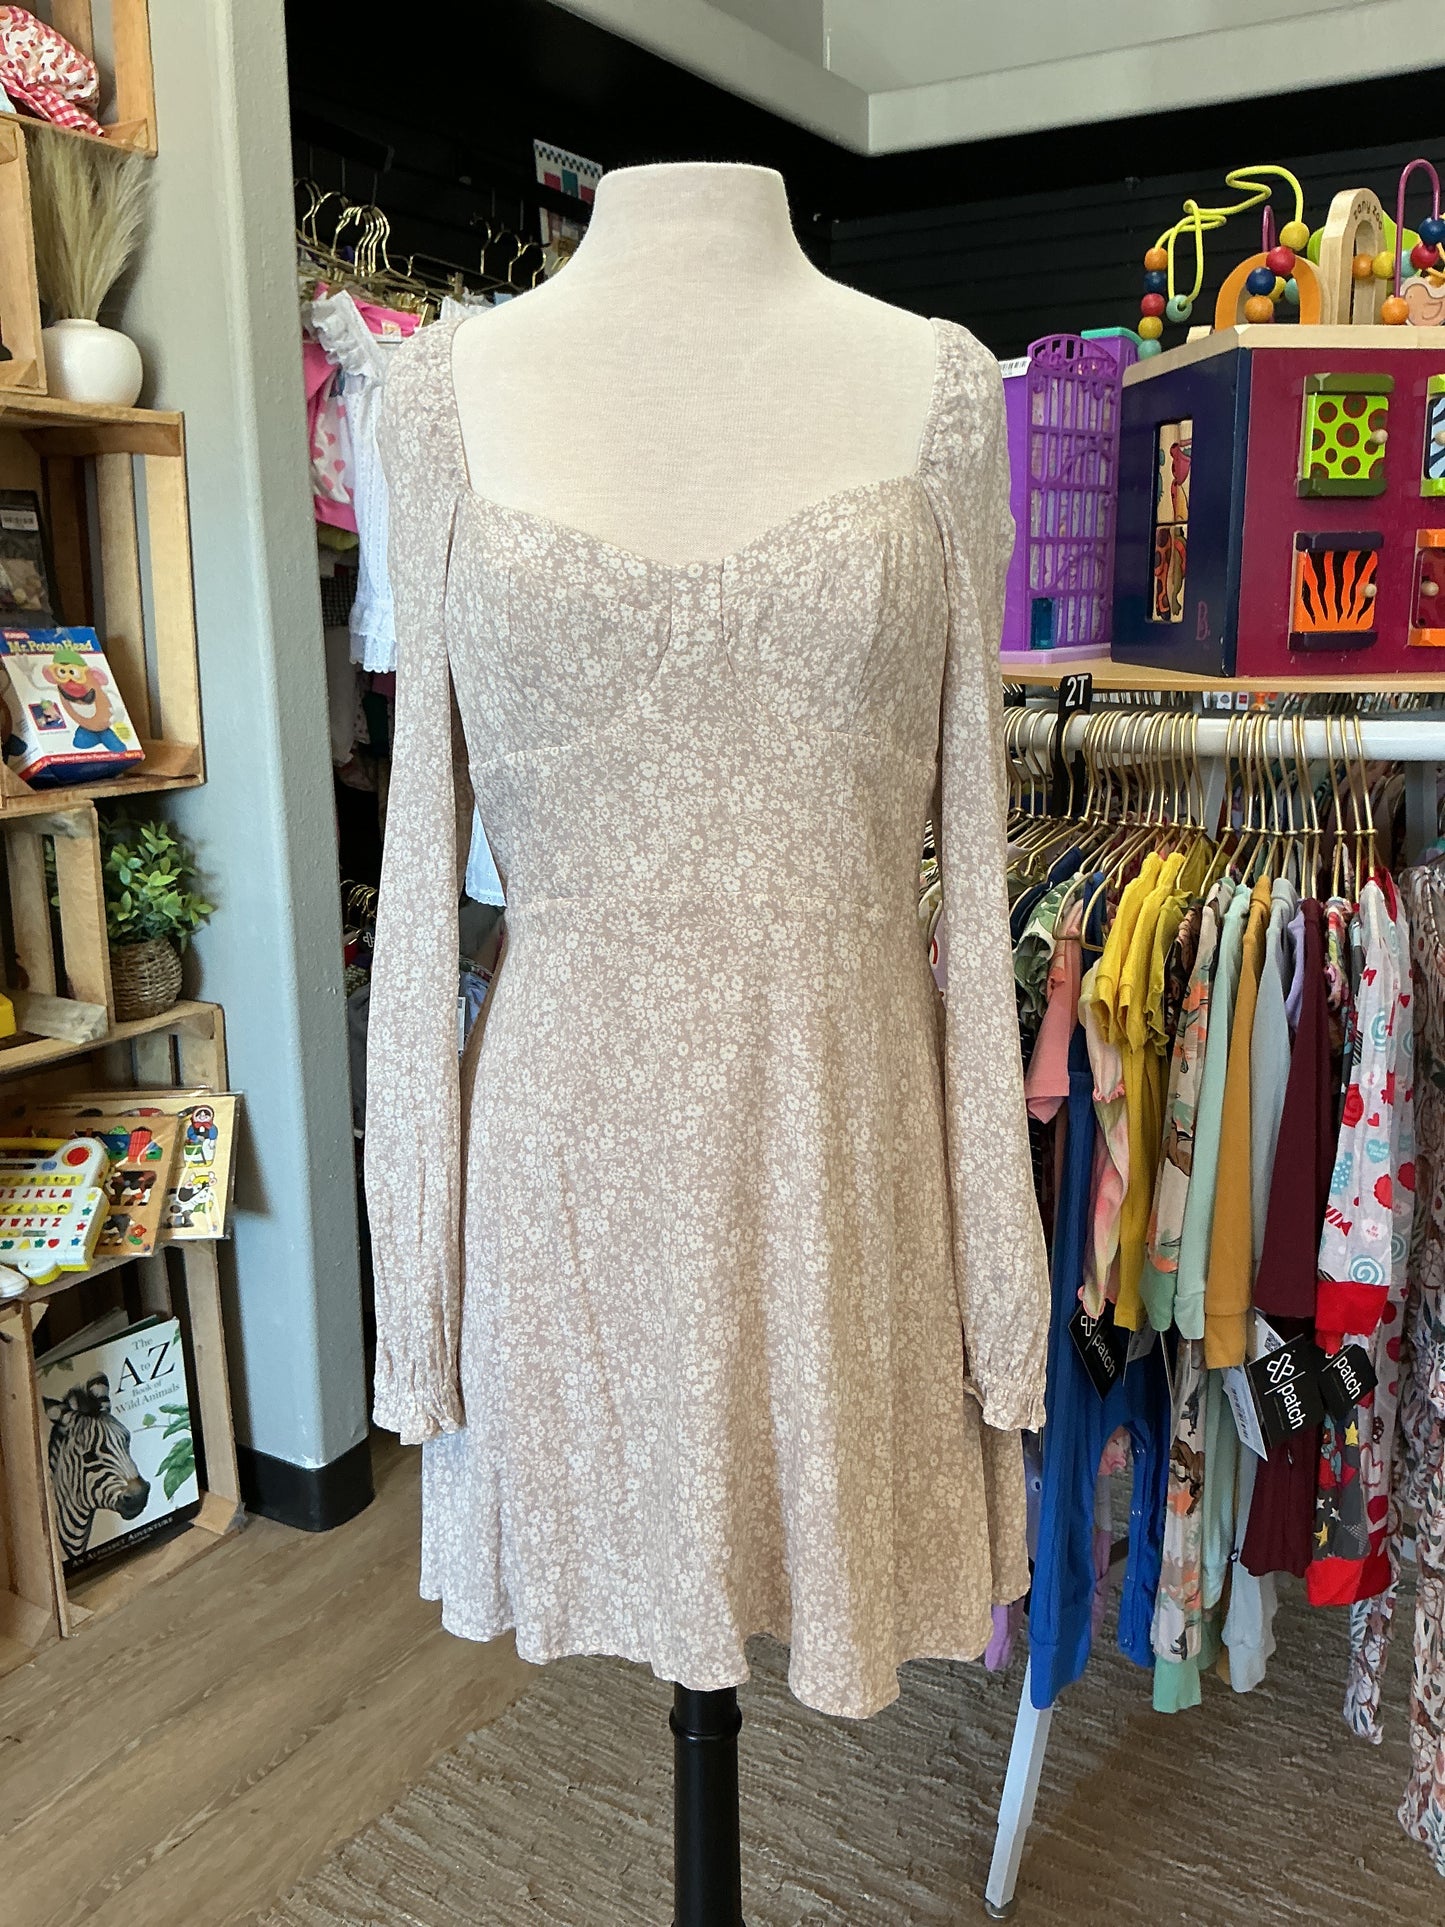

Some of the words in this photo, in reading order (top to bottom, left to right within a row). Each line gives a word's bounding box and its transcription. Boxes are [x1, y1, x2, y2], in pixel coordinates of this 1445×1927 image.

[1372, 205, 1383, 231] zoo
[28, 641, 63, 652] Potato
[62, 639, 94, 652] Head
[1065, 675, 1089, 707] 2T
[132, 1338, 153, 1350] The
[1092, 1334, 1116, 1378] patch
[115, 1356, 146, 1394] A
[140, 1362, 151, 1371] to
[147, 1340, 175, 1380] Z
[1333, 1355, 1362, 1400] patch
[115, 1397, 141, 1413] Wild
[142, 1383, 180, 1403] Animals
[132, 1383, 152, 1397] Book
[153, 1380, 162, 1389] of
[1276, 1382, 1306, 1430] patch
